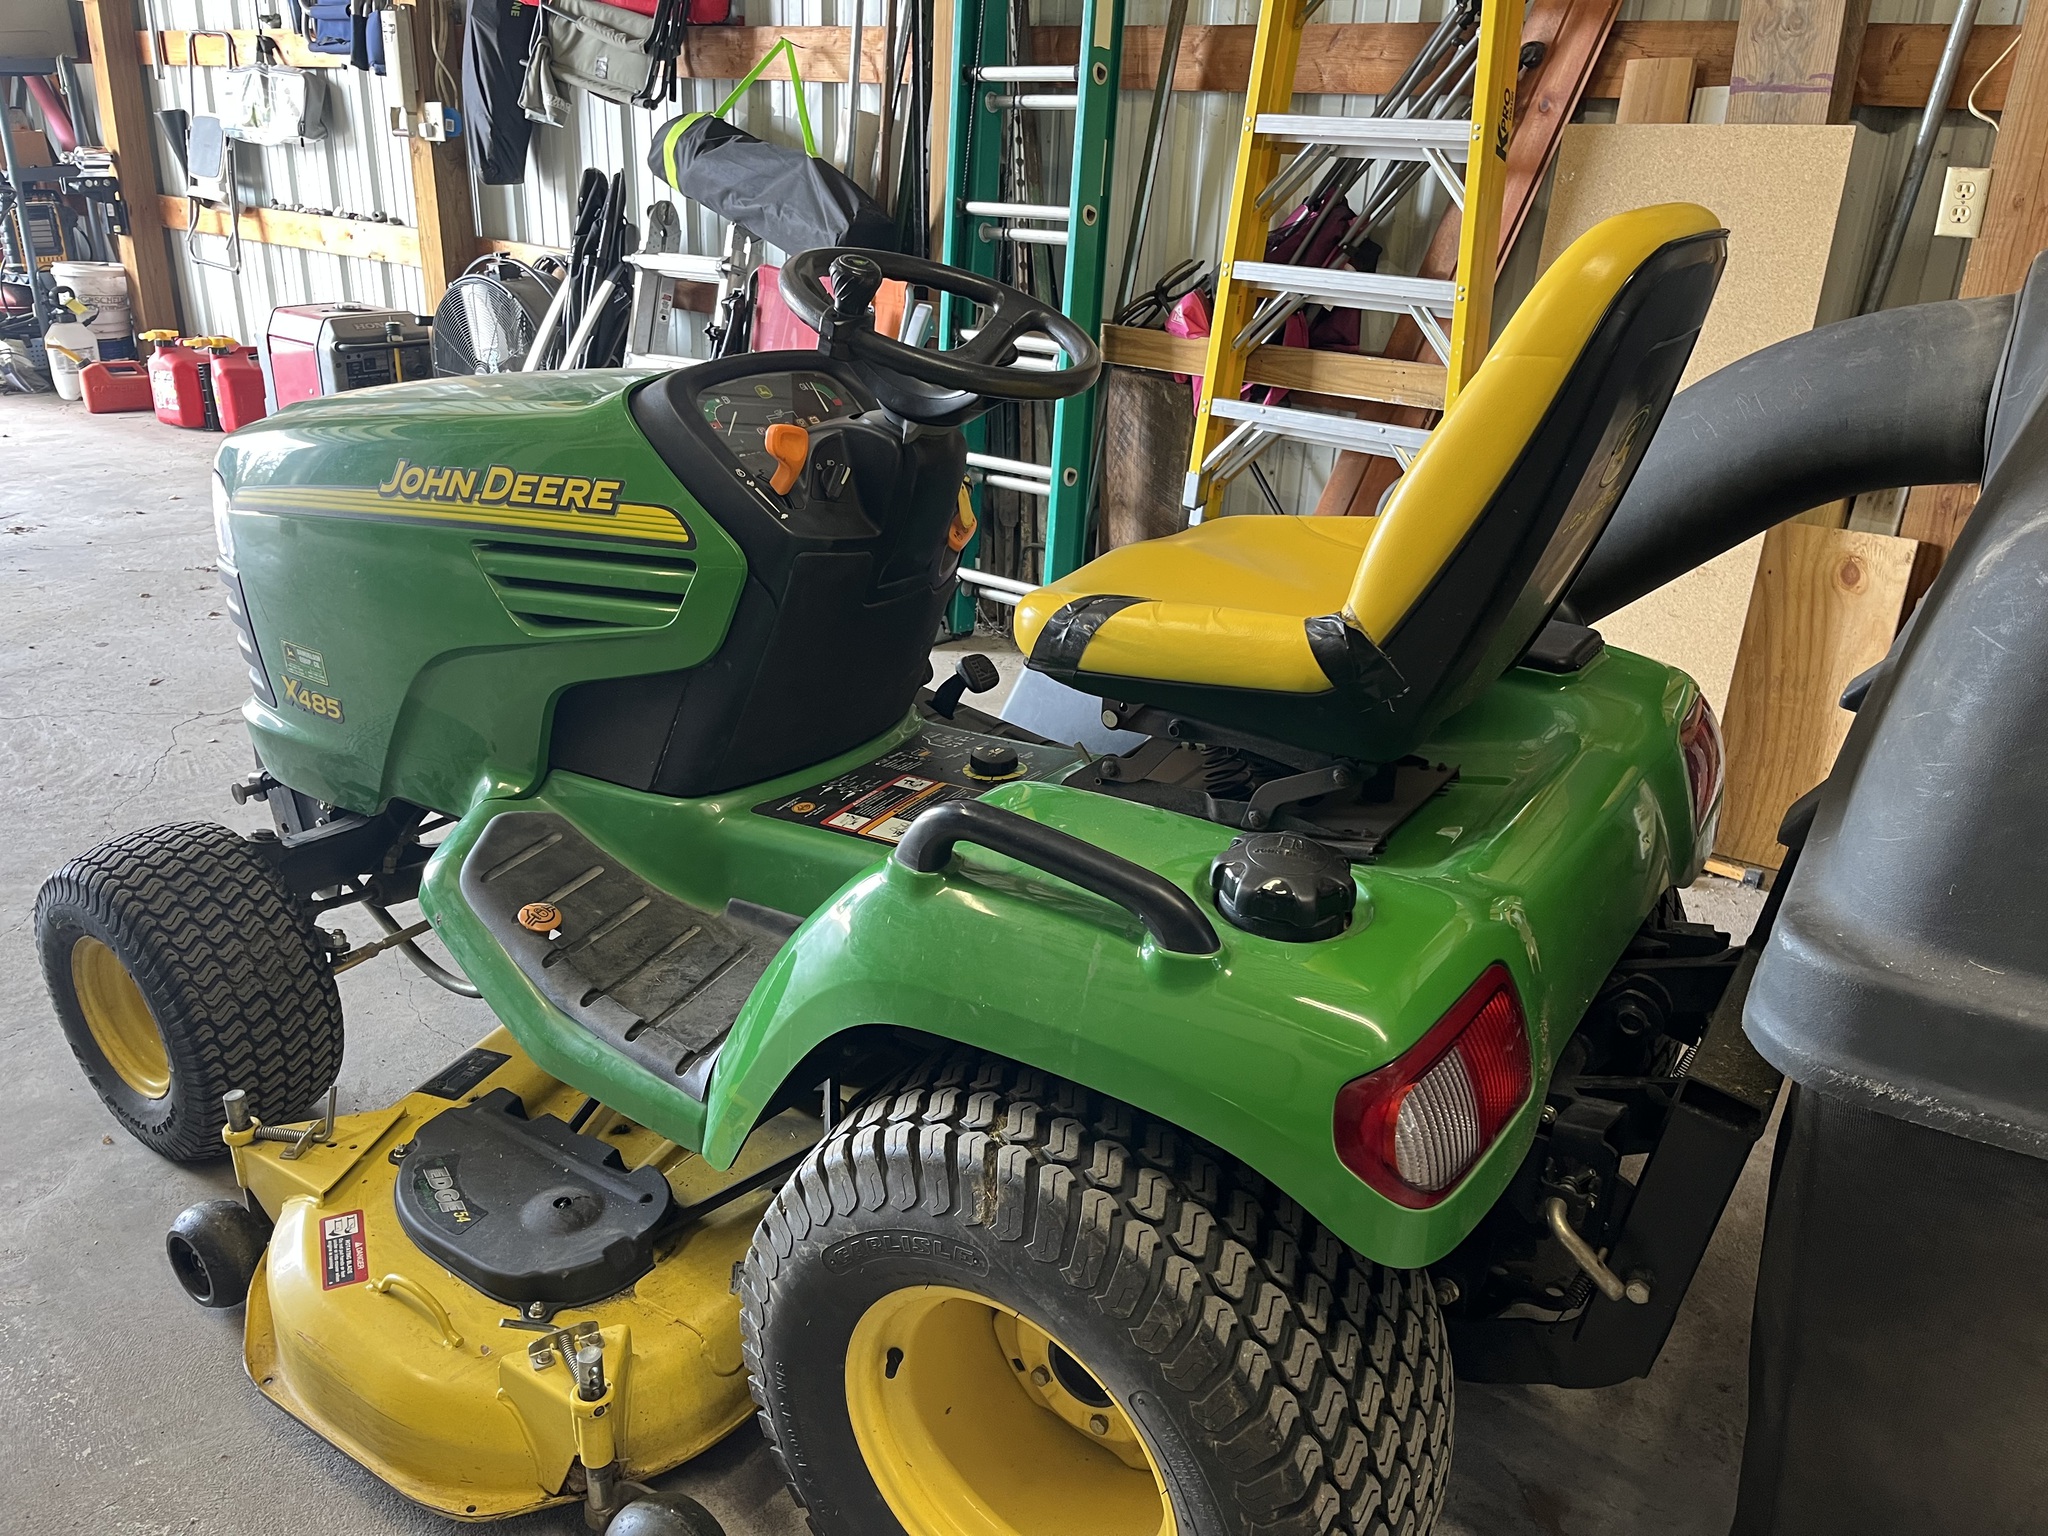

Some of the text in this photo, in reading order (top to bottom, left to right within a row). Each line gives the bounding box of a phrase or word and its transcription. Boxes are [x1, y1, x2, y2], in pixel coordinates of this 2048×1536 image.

[379, 459, 622, 511] JOHN DEERE
[281, 674, 341, 719] X485
[423, 1166, 467, 1213] EDGE
[453, 1211, 472, 1223] 54
[356, 1246, 365, 1270] DANGER
[833, 1235, 974, 1267] CARLISLE
